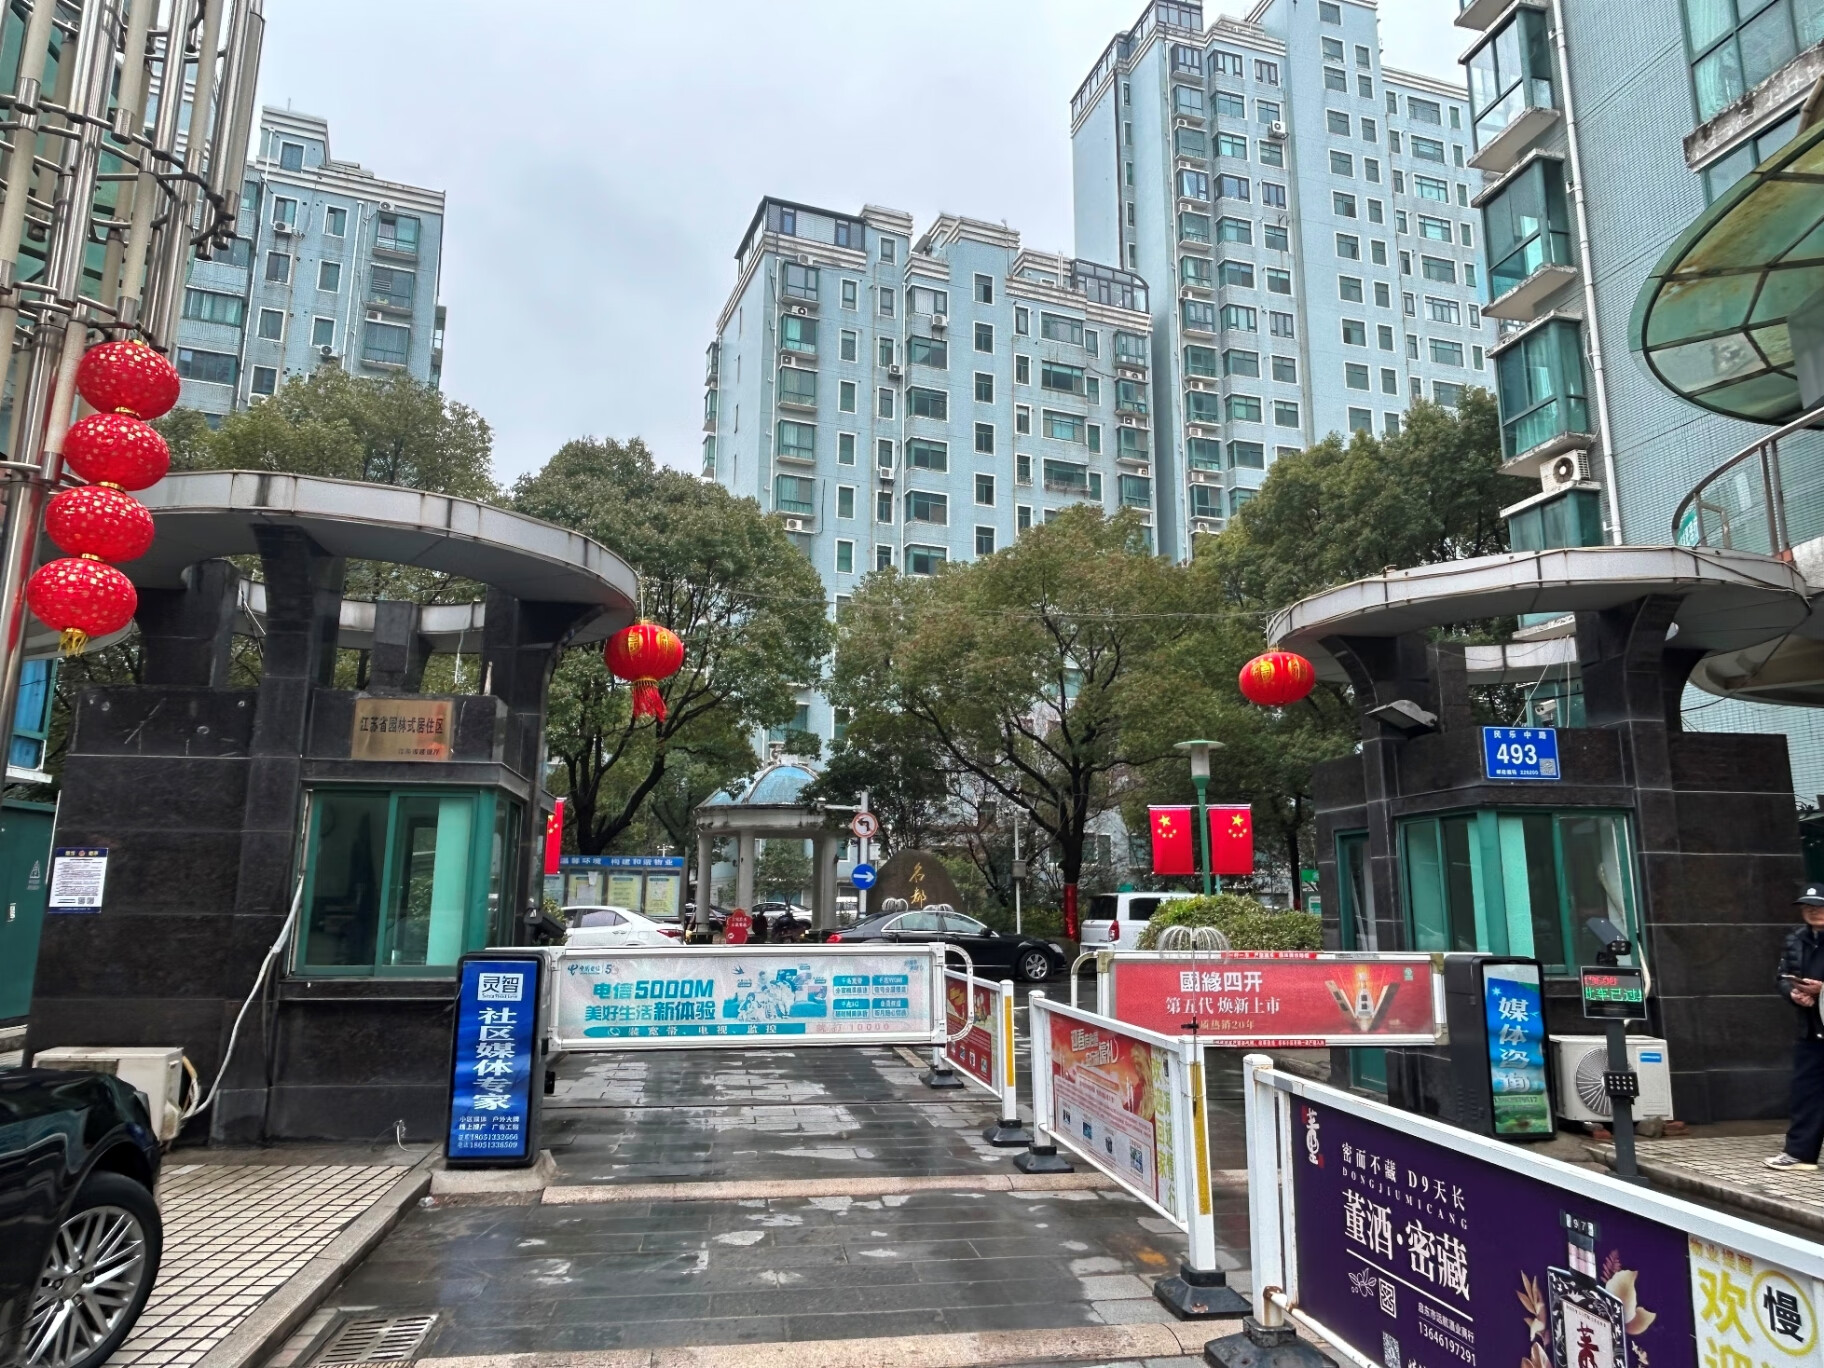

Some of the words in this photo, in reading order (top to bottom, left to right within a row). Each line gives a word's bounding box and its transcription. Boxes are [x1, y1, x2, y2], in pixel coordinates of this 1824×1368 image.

[360, 717, 444, 734] 江苏省园林式居住区
[1493, 730, 1547, 740] 民乐中路
[1496, 743, 1538, 765] 493
[482, 975, 519, 993] 灵智
[593, 979, 714, 1000] 电信5000M
[1180, 971, 1262, 992] 國緣四开
[585, 1001, 716, 1021] 美好生活新体验
[1166, 997, 1213, 1014] 第五代
[1217, 997, 1280, 1014] 焕新上市
[473, 1007, 518, 1111] 社区媒体专家
[1408, 1169, 1465, 1212] D9天长
[1763, 1284, 1805, 1343] 慢
[1419, 1321, 1476, 1367] 13646197291
